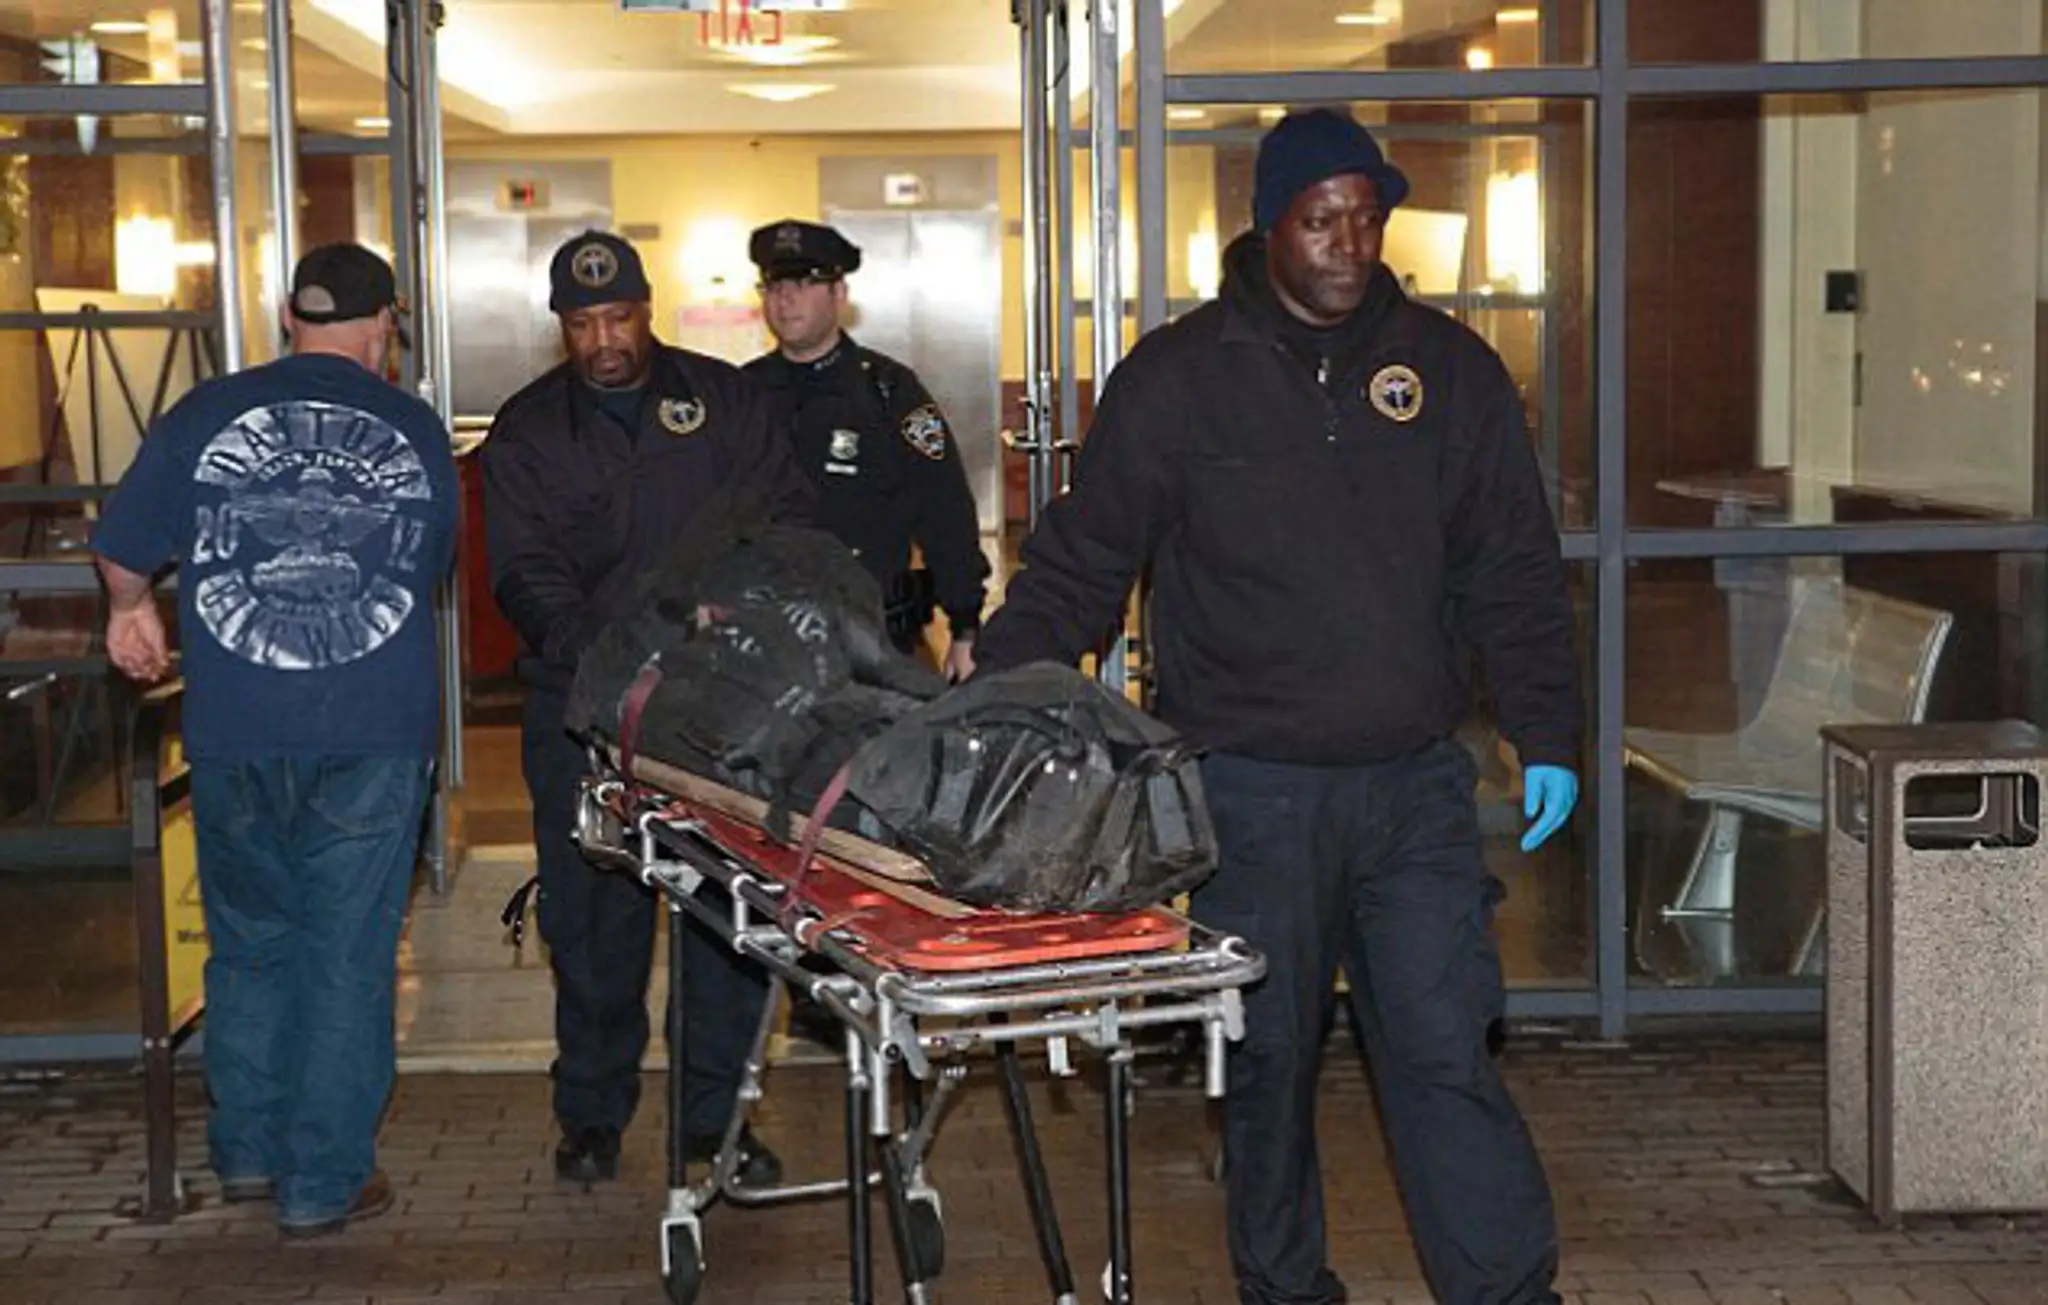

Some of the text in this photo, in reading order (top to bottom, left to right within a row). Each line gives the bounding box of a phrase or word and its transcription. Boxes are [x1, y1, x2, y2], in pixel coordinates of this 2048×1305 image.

[203, 403, 421, 491] DAYTONA
[192, 504, 239, 563] 20
[386, 517, 425, 573] 12
